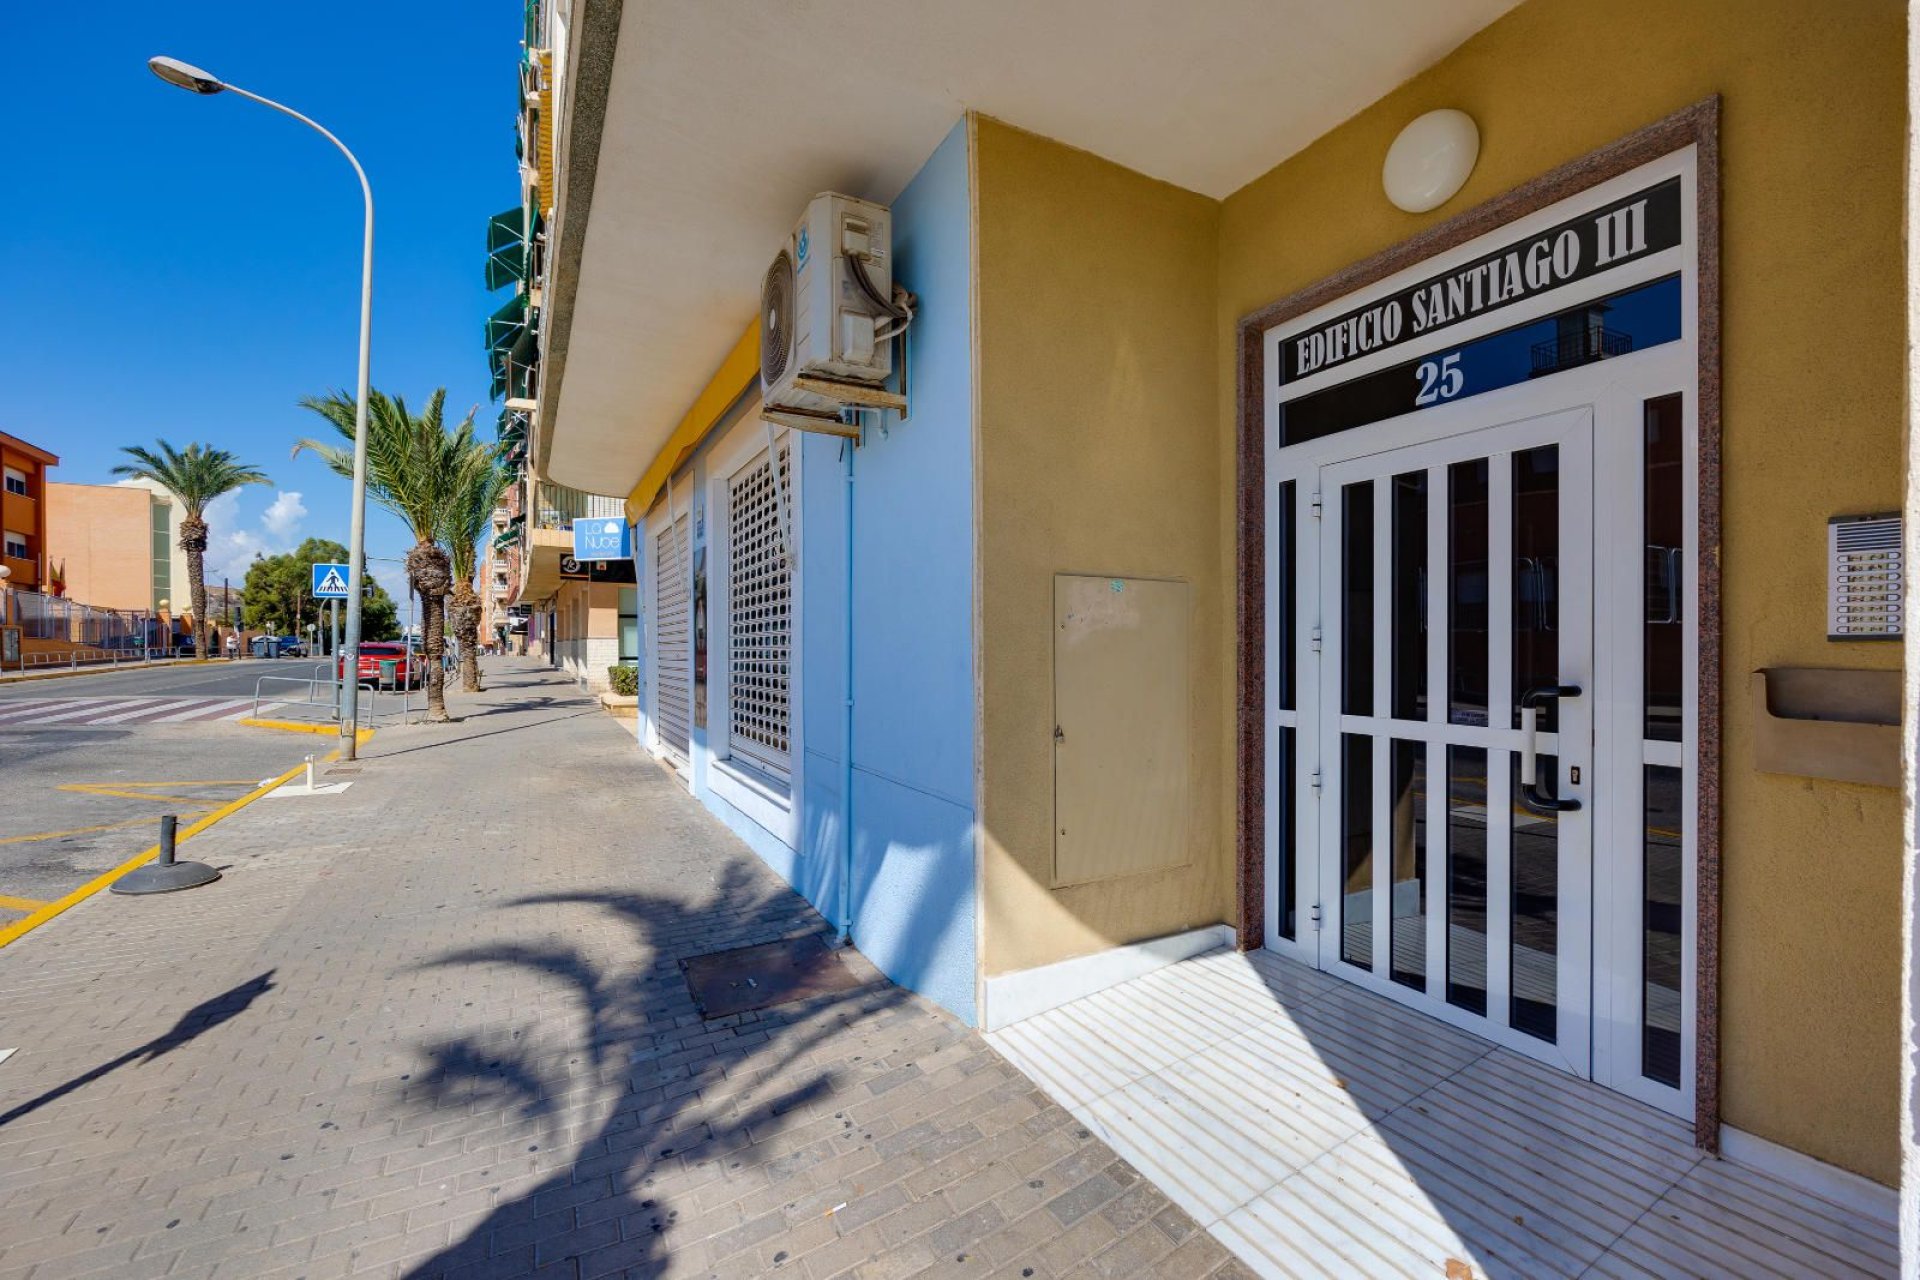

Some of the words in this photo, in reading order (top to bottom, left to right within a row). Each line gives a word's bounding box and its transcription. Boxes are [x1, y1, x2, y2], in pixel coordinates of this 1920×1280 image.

[1296, 300, 1403, 376] EDIFICIO
[1411, 229, 1581, 333] SANTIAGO
[1594, 199, 1648, 267] III
[1415, 351, 1465, 406] 25
